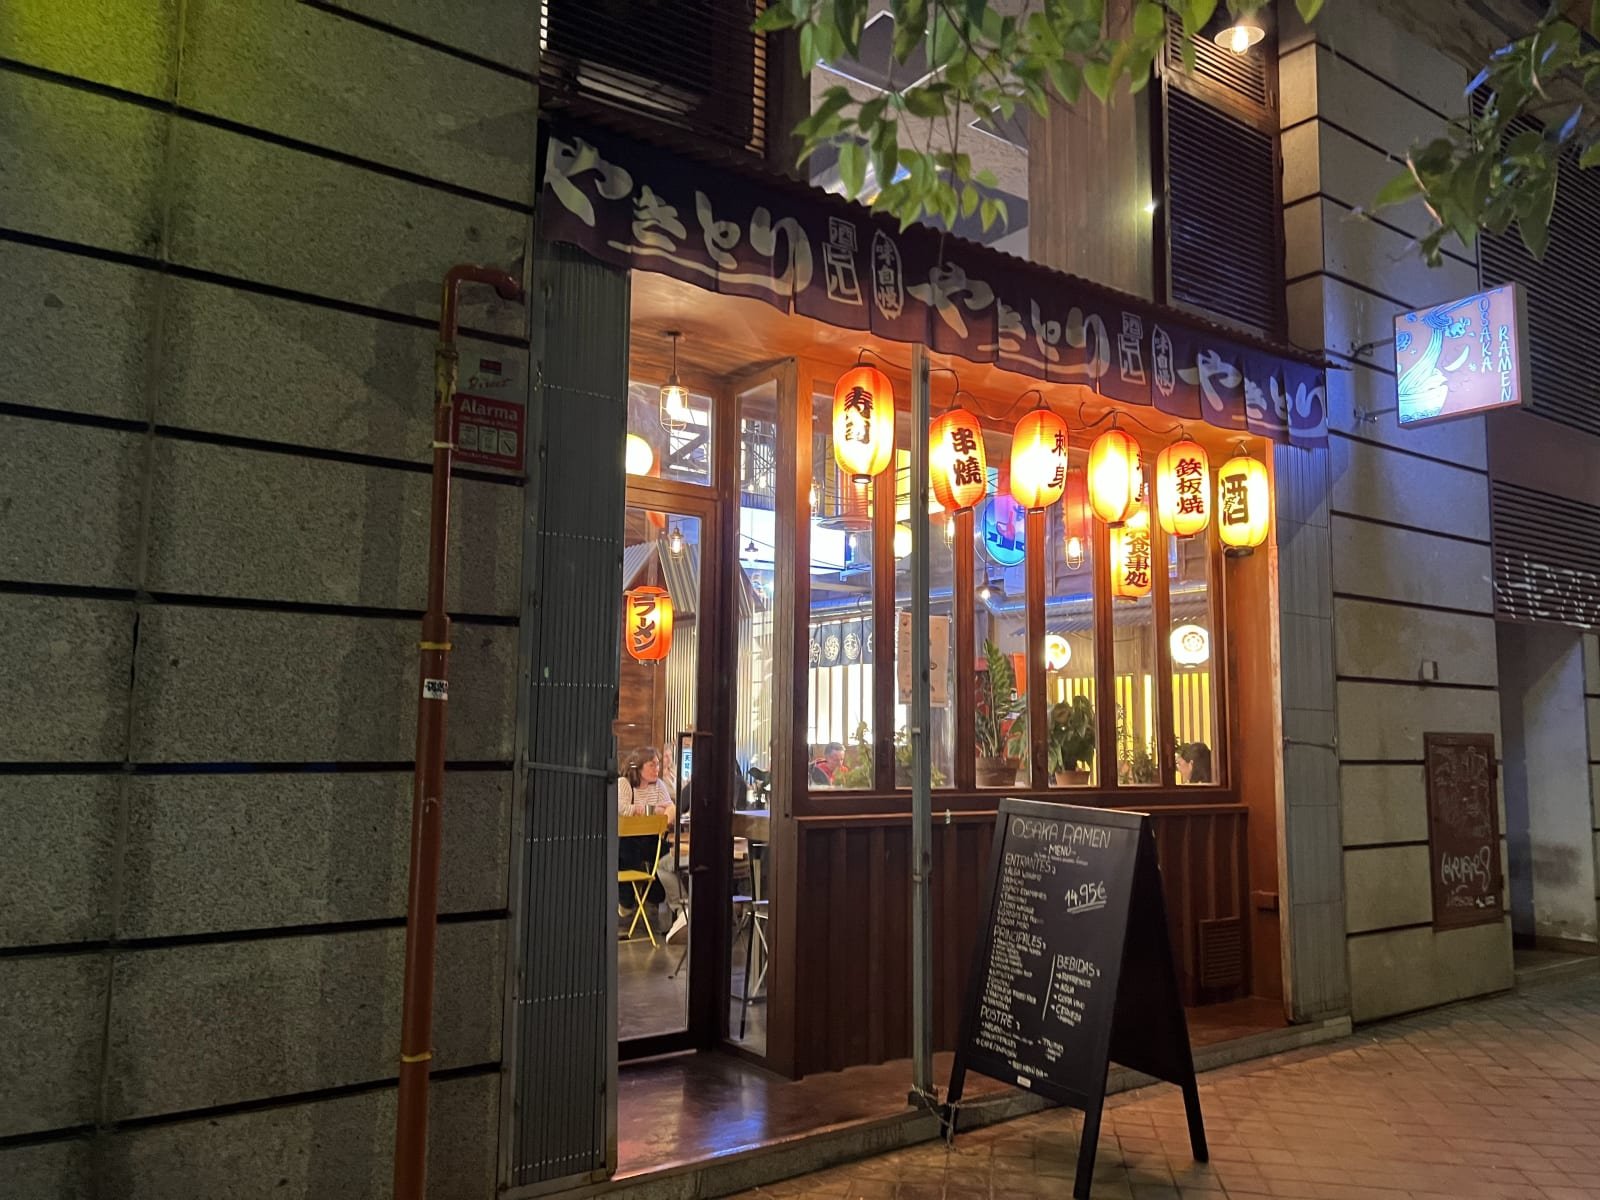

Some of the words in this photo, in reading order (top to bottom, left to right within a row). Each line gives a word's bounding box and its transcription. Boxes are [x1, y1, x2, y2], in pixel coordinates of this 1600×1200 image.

[1478, 297, 1492, 374] OSAKA
[1498, 325, 1512, 402] RAMEN
[460, 398, 518, 420] Alarma
[633, 597, 656, 653] ラーメン
[1012, 817, 1059, 840] OSAKA
[1062, 823, 1112, 849] RAMEN
[1057, 954, 1095, 977] BEBIDAS
[980, 1005, 1014, 1029] POSTRE
